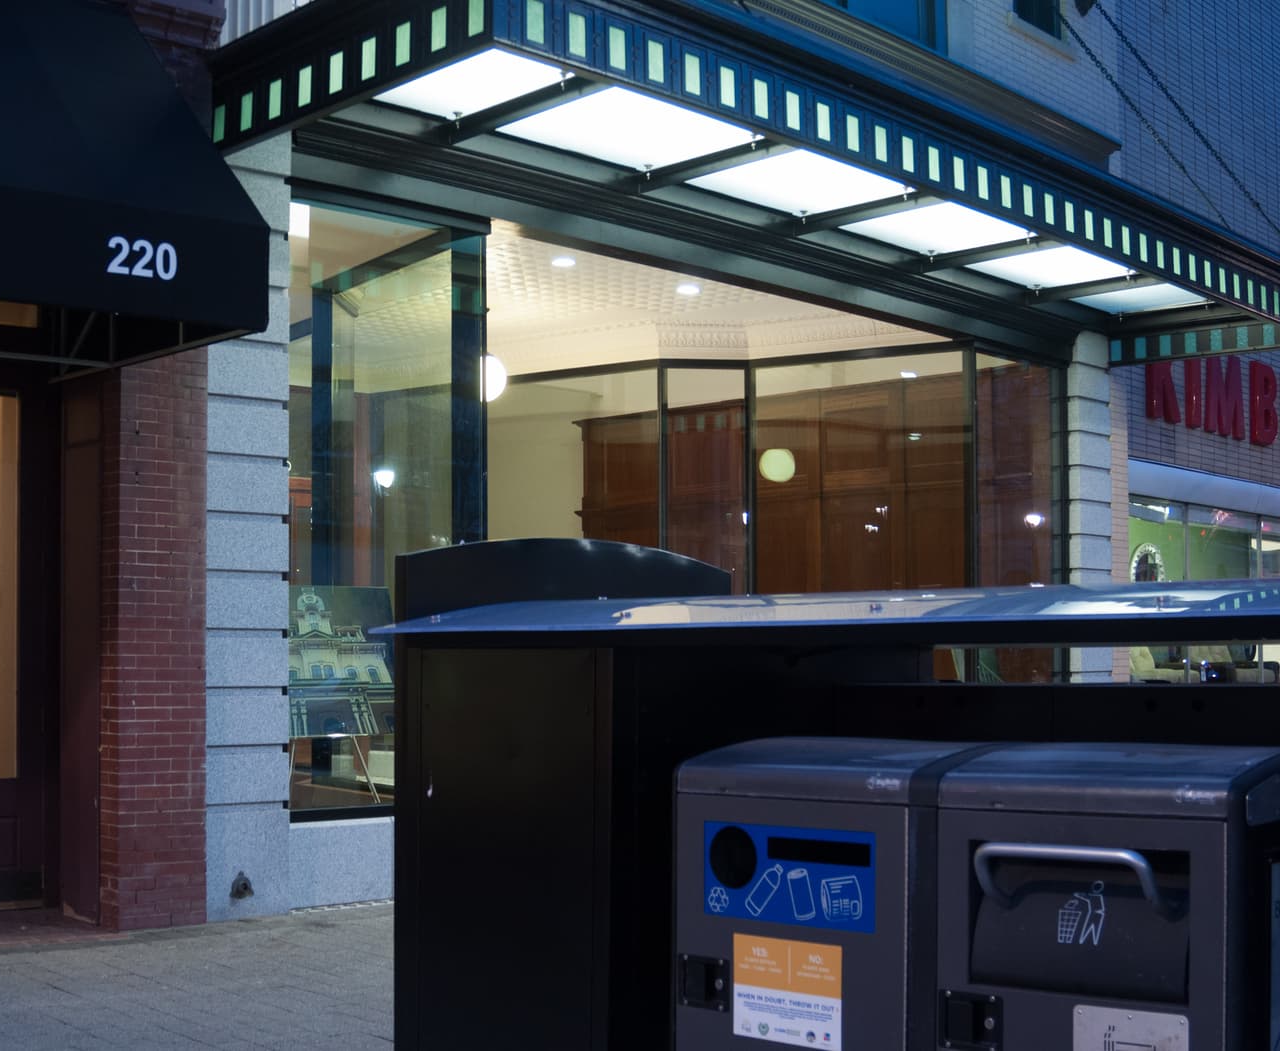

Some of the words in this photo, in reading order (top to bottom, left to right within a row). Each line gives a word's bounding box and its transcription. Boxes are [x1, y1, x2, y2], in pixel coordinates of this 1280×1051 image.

[106, 236, 177, 280] 220
[1145, 355, 1278, 446] KIMB
[789, 1000, 812, 1009] THROW
